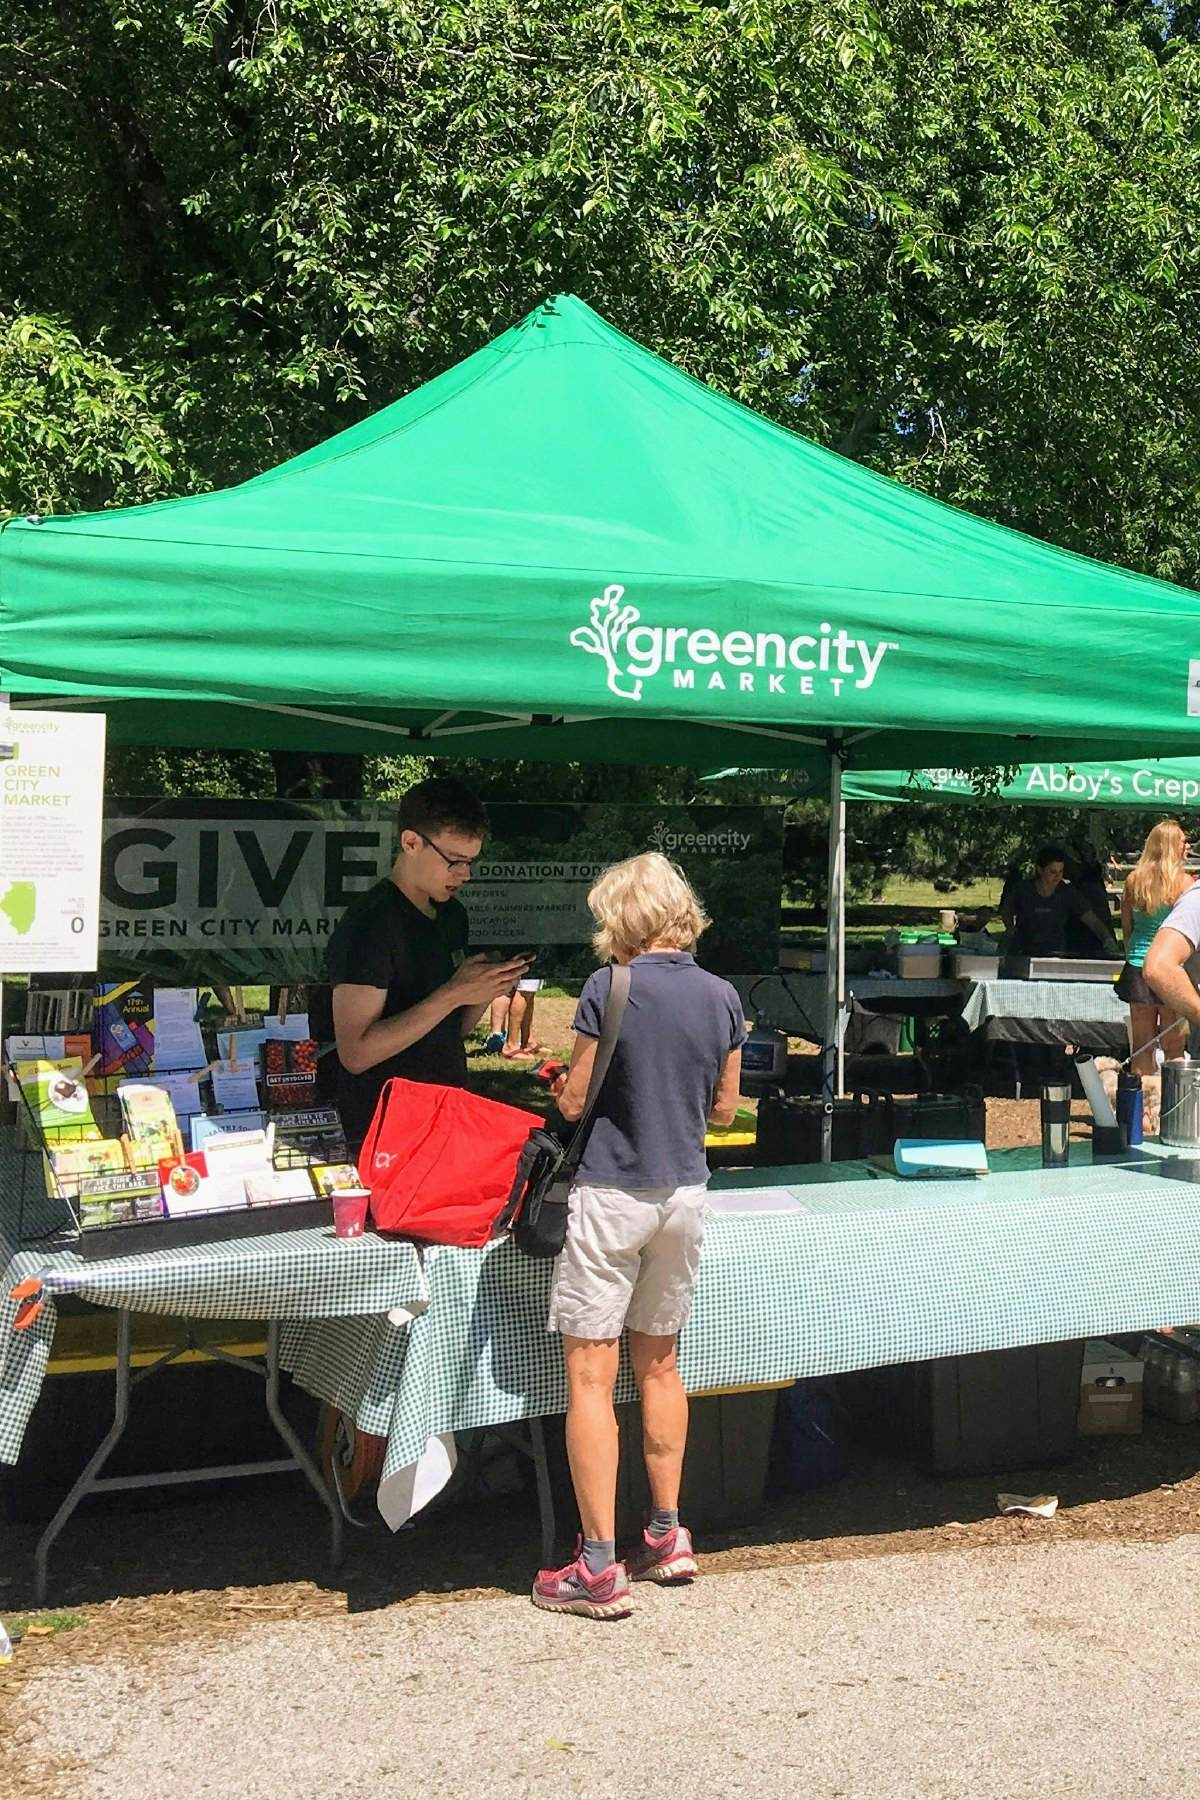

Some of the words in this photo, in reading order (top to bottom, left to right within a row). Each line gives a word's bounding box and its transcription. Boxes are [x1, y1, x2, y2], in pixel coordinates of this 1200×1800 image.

[673, 669, 844, 697] MARKET
[4, 765, 60, 777] GREEN
[4, 779, 39, 791] CITY
[1026, 765, 1123, 800] Abby's
[4, 794, 72, 806] MARKET
[665, 829, 751, 850] greencity
[680, 847, 736, 855] MARKET
[101, 828, 381, 910] GIVE
[480, 865, 564, 877] DONATION
[570, 865, 601, 877] TOD
[71, 916, 84, 933] 0
[98, 919, 187, 937] GREEN
[200, 918, 260, 936] CITY
[272, 918, 338, 936] MAR
[122, 1005, 150, 1013] Annual
